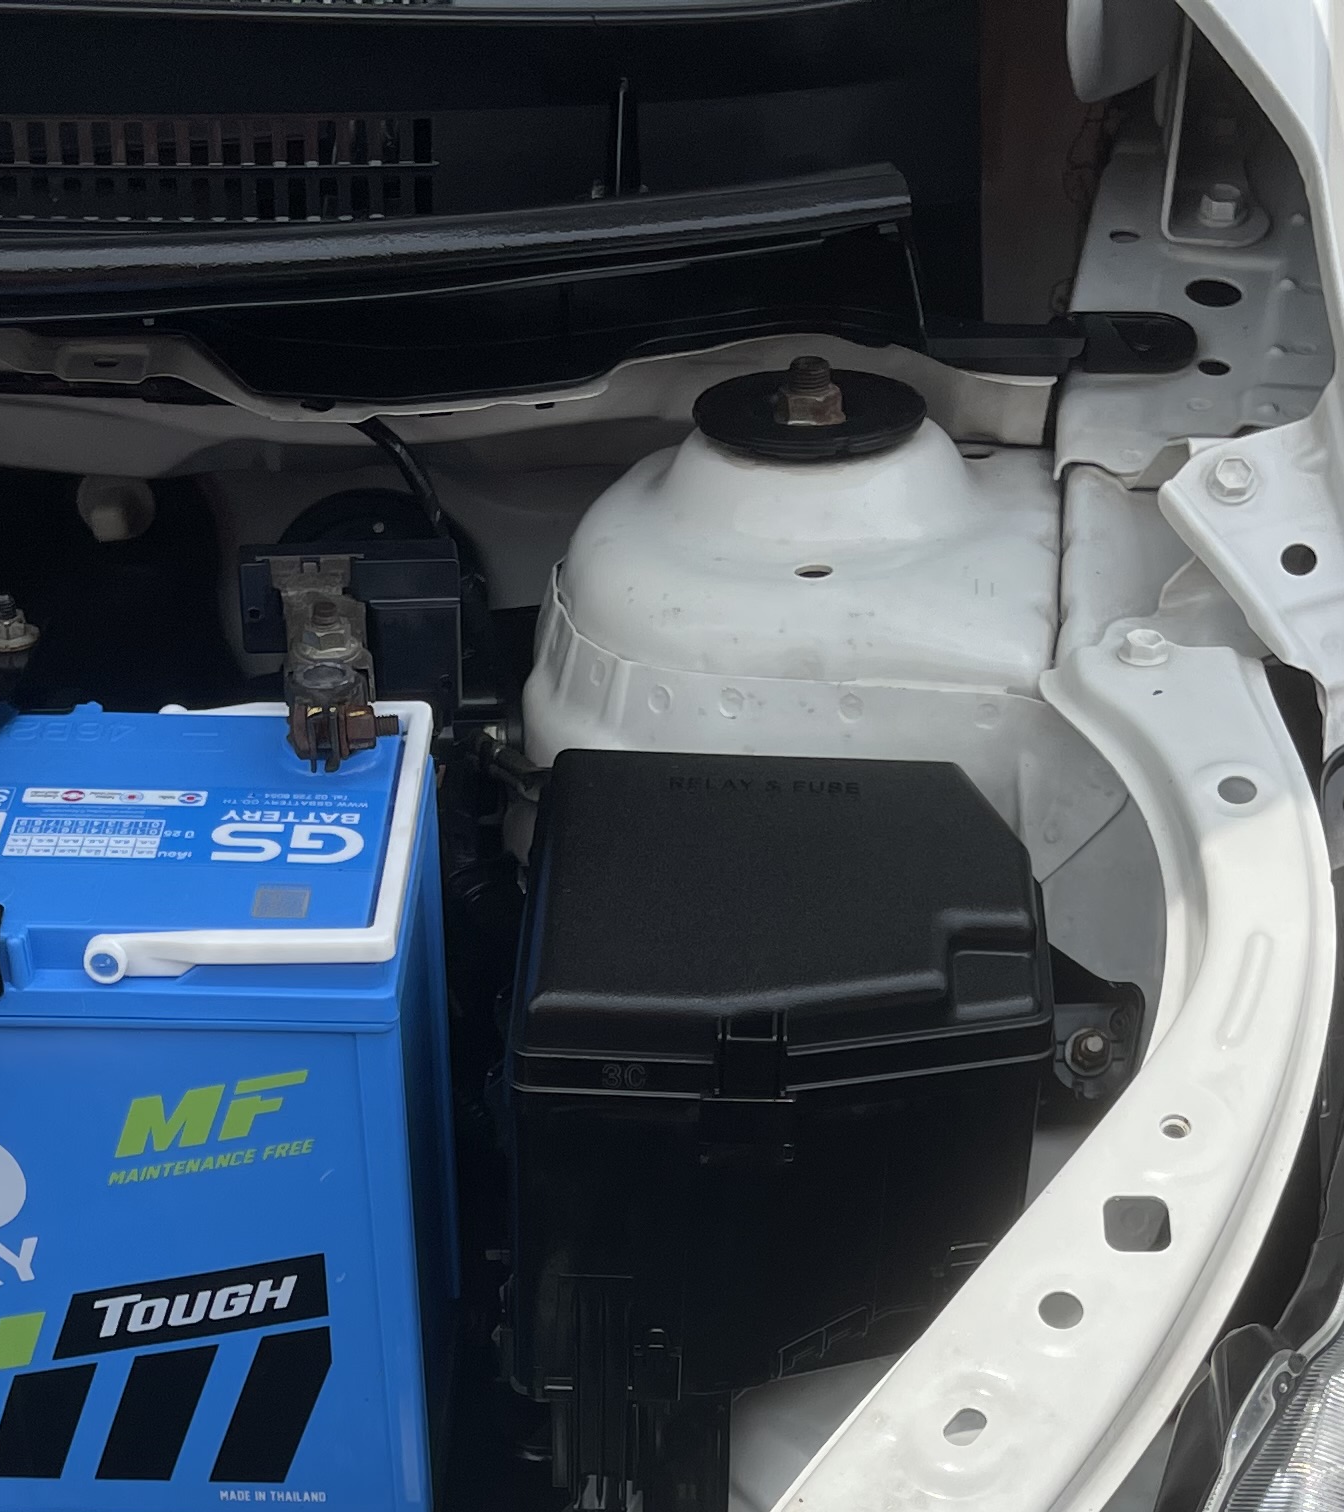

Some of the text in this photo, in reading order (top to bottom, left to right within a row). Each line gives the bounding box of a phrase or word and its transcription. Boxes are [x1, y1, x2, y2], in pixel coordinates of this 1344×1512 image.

[792, 779, 860, 795] FUSE
[220, 810, 361, 824] BATTERY
[210, 823, 365, 864] GS
[115, 1069, 308, 1158] MF
[108, 1139, 316, 1186] MAINTENANCE FREE
[92, 1274, 299, 1339] TOUGH
[219, 1489, 327, 1503] MADE IN THAILAND
